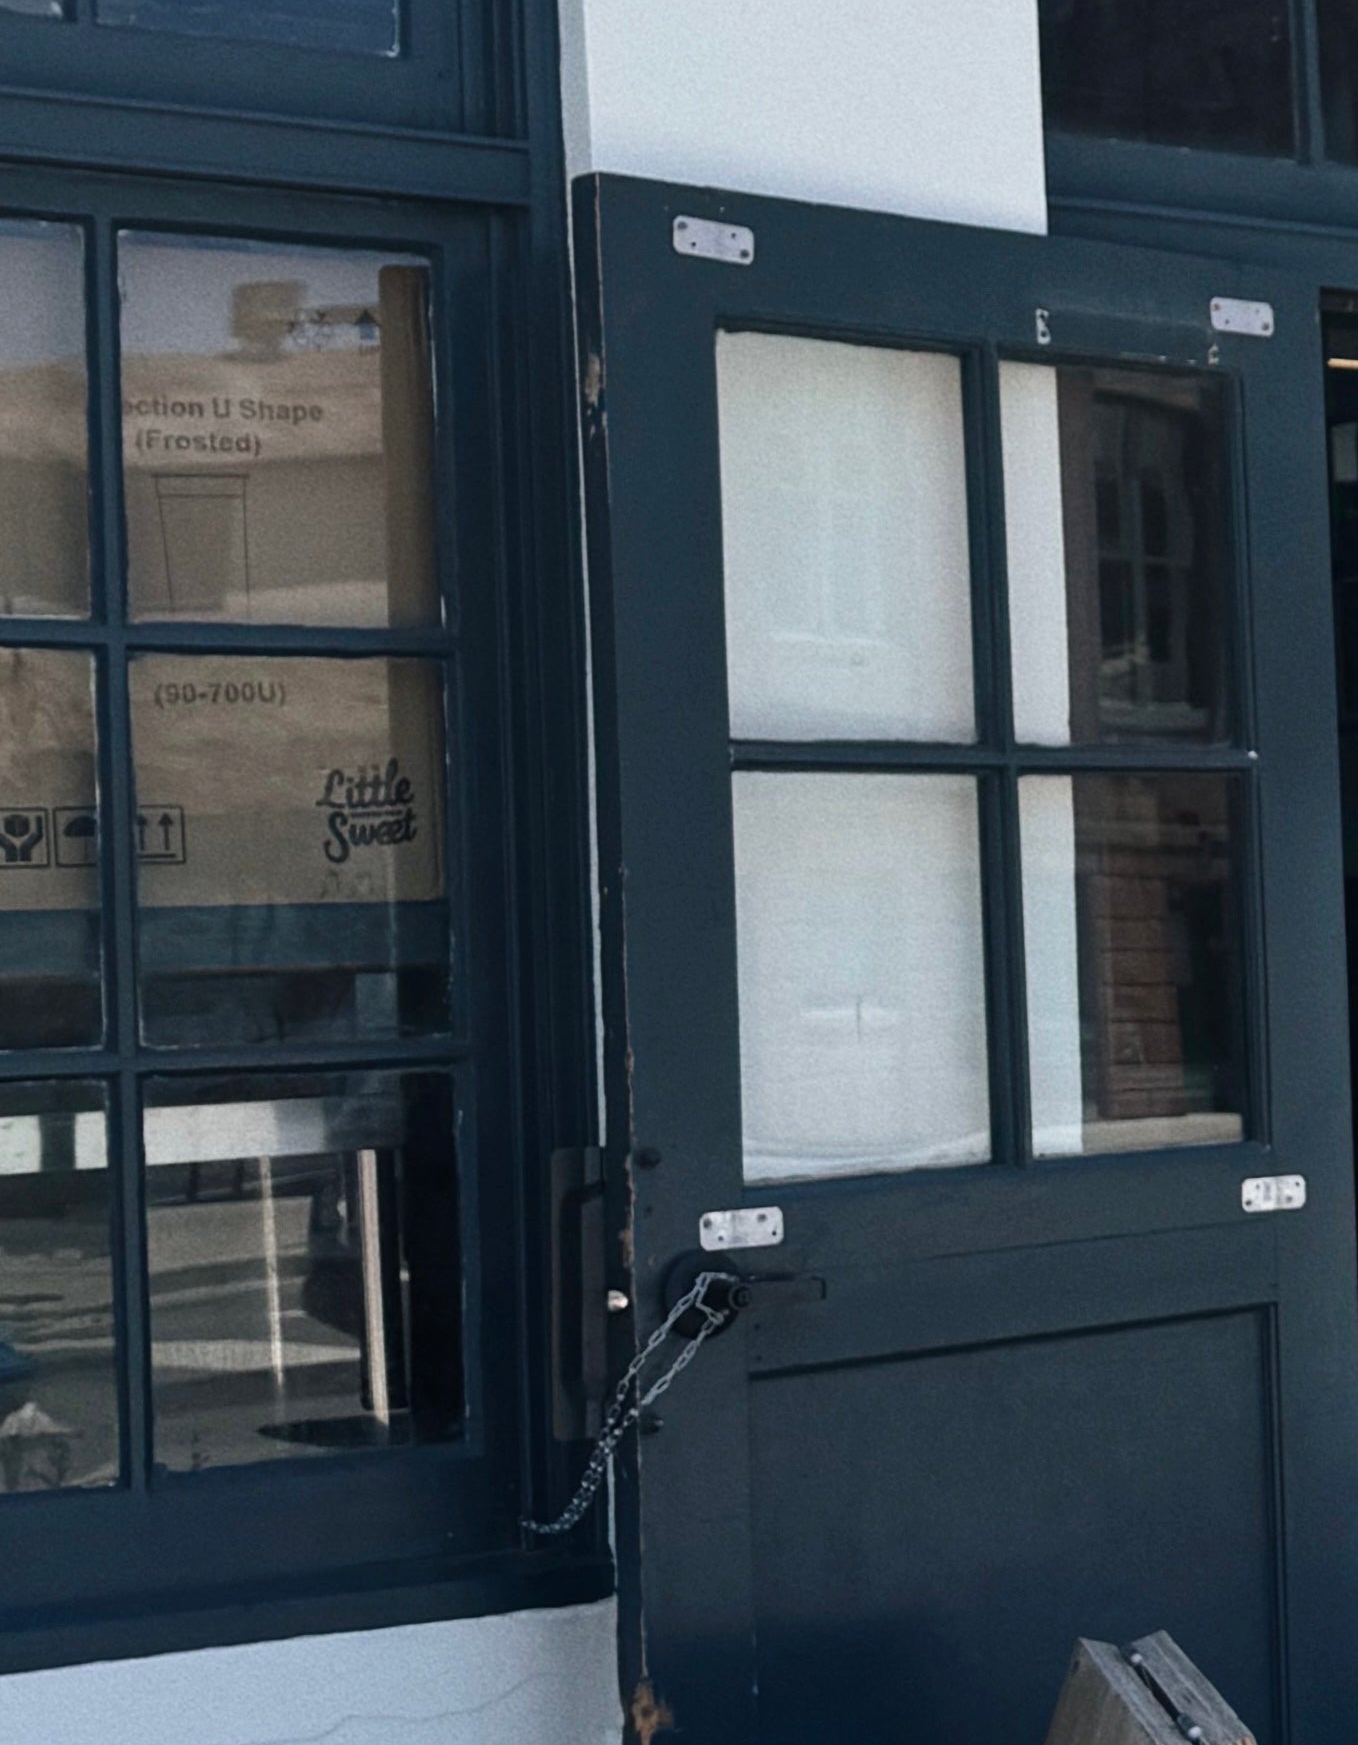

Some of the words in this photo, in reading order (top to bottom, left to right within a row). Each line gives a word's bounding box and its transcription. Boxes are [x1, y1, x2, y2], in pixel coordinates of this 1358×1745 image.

[212, 398, 230, 419] U
[239, 399, 323, 425] Shape
[135, 429, 262, 456] (Frosted)
[153, 682, 286, 709] (90-700U)
[315, 757, 414, 809] Little
[323, 808, 417, 863] Sweet
